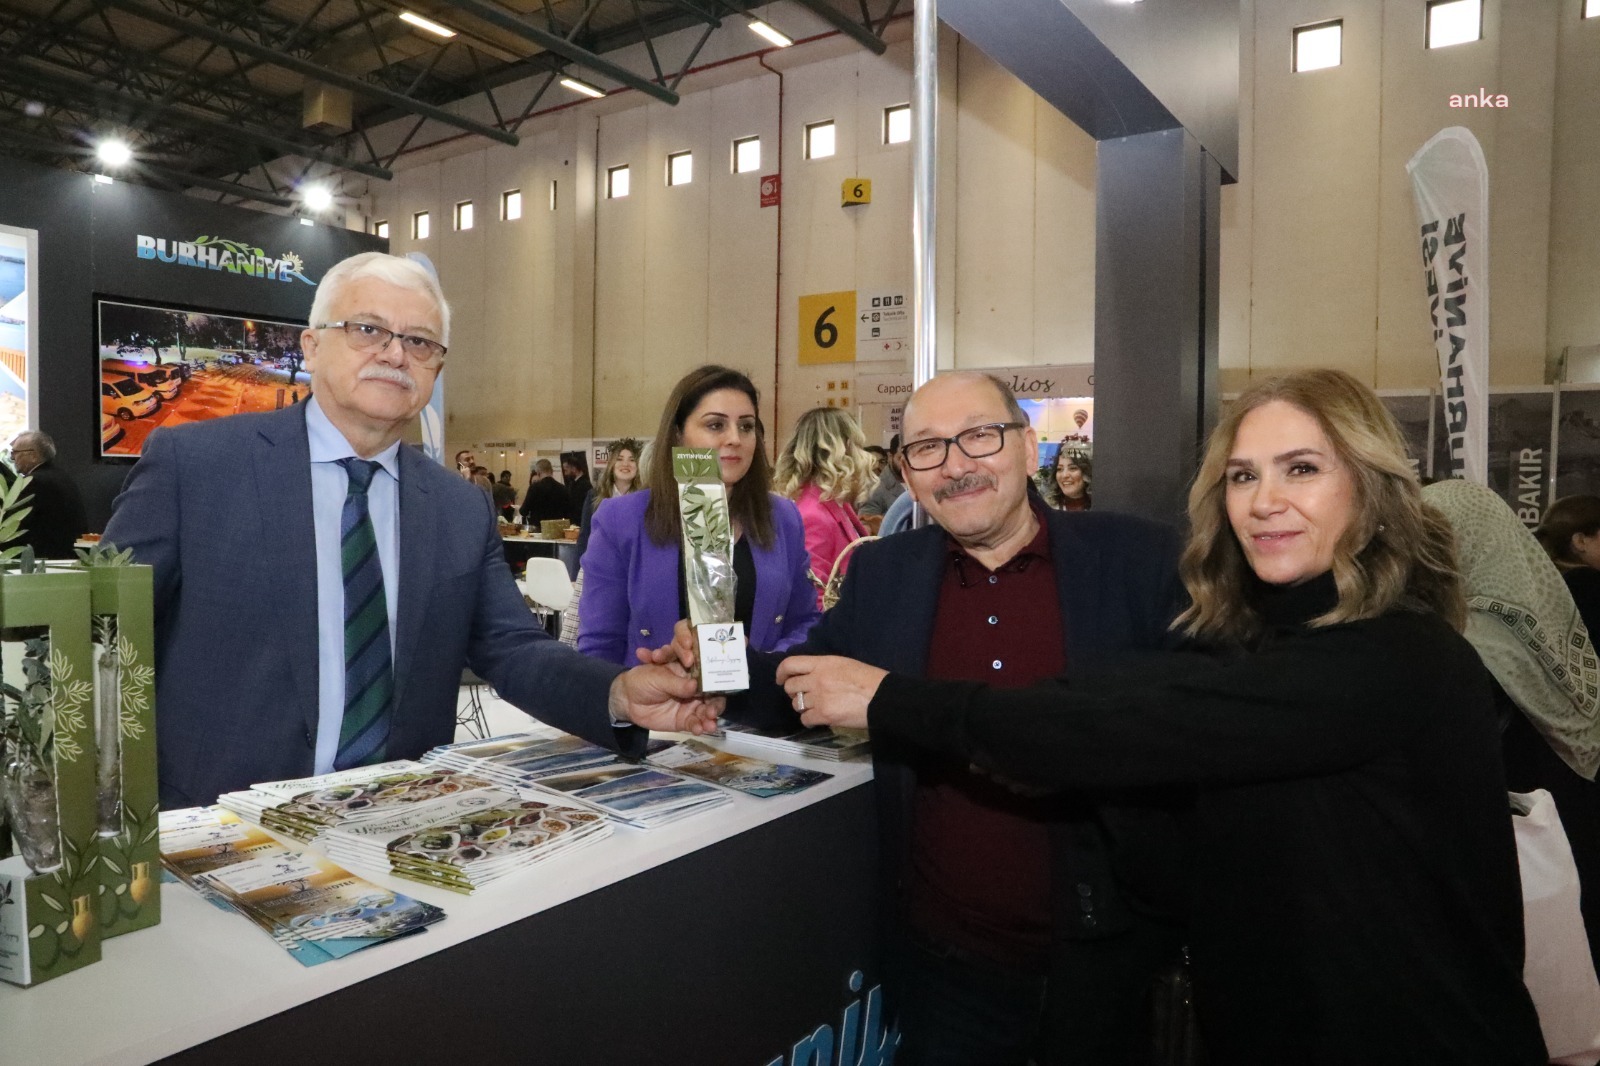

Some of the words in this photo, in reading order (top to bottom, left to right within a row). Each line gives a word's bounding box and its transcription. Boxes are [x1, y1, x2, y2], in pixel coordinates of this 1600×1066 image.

[853, 183, 863, 198] 6
[814, 306, 838, 349] 6
[877, 383, 913, 395] Cappad
[1518, 448, 1543, 532] BAKIR
